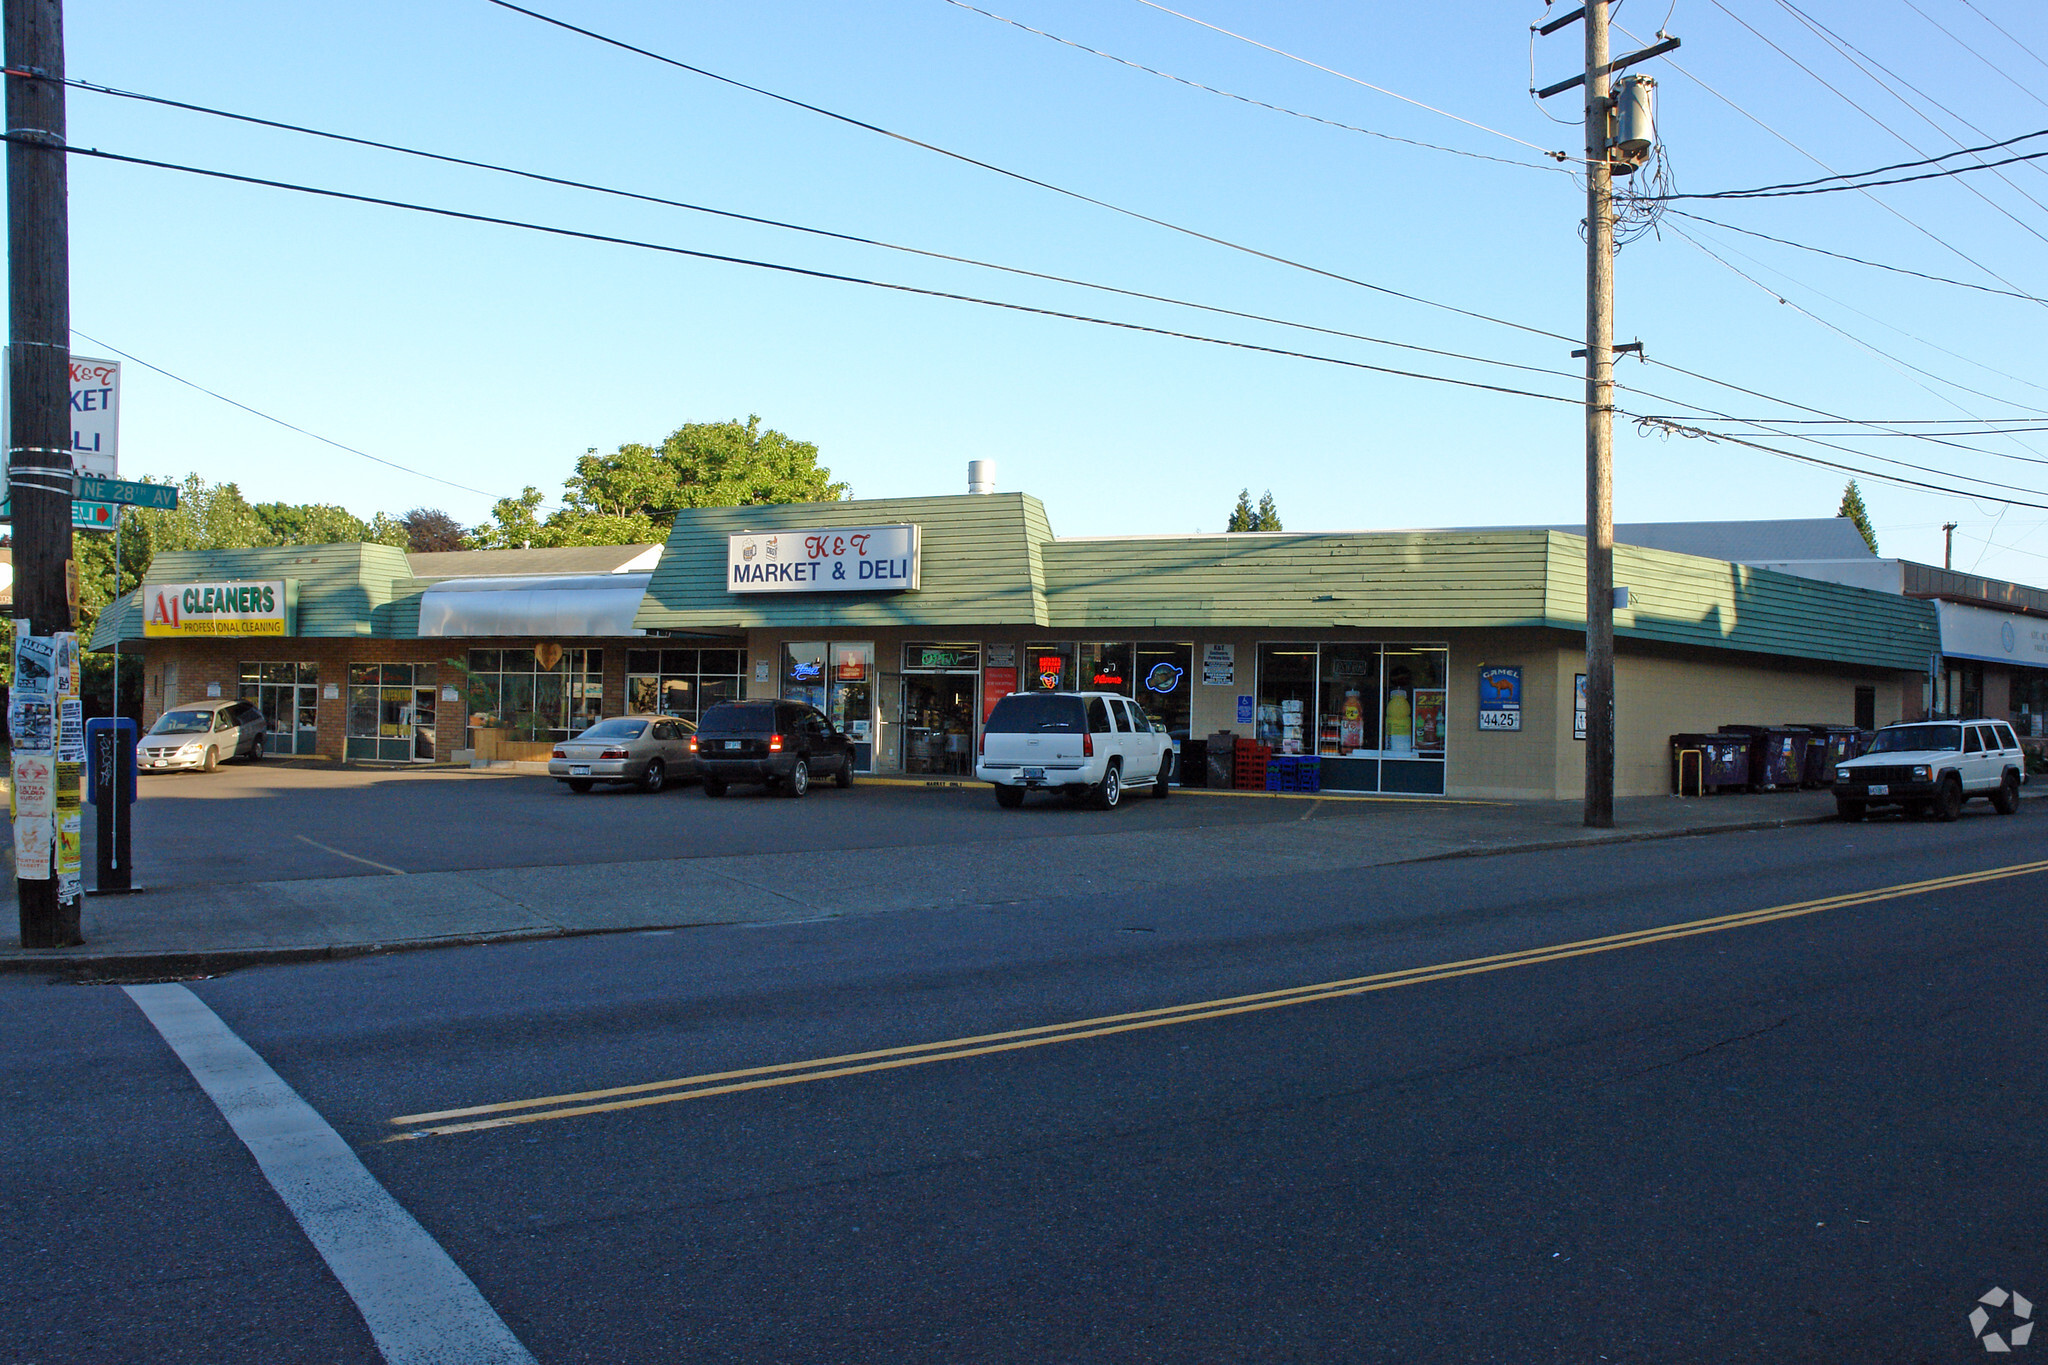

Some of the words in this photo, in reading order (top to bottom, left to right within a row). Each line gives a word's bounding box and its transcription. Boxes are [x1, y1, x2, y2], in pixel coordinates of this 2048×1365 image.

[70, 388, 113, 411] KET
[84, 481, 105, 498] NE
[114, 485, 146, 500] 28TH
[153, 490, 173, 505] AV
[72, 506, 93, 520] ELI
[734, 562, 820, 583] MARKET
[832, 561, 846, 580] &
[859, 559, 907, 580] DELI
[151, 591, 181, 629] A1
[183, 586, 275, 614] CLEANERS
[184, 622, 240, 632] PROFESSIONAL
[241, 621, 281, 632] CLEANING
[922, 653, 959, 665] OPEN
[1483, 669, 1519, 678] CAMEL
